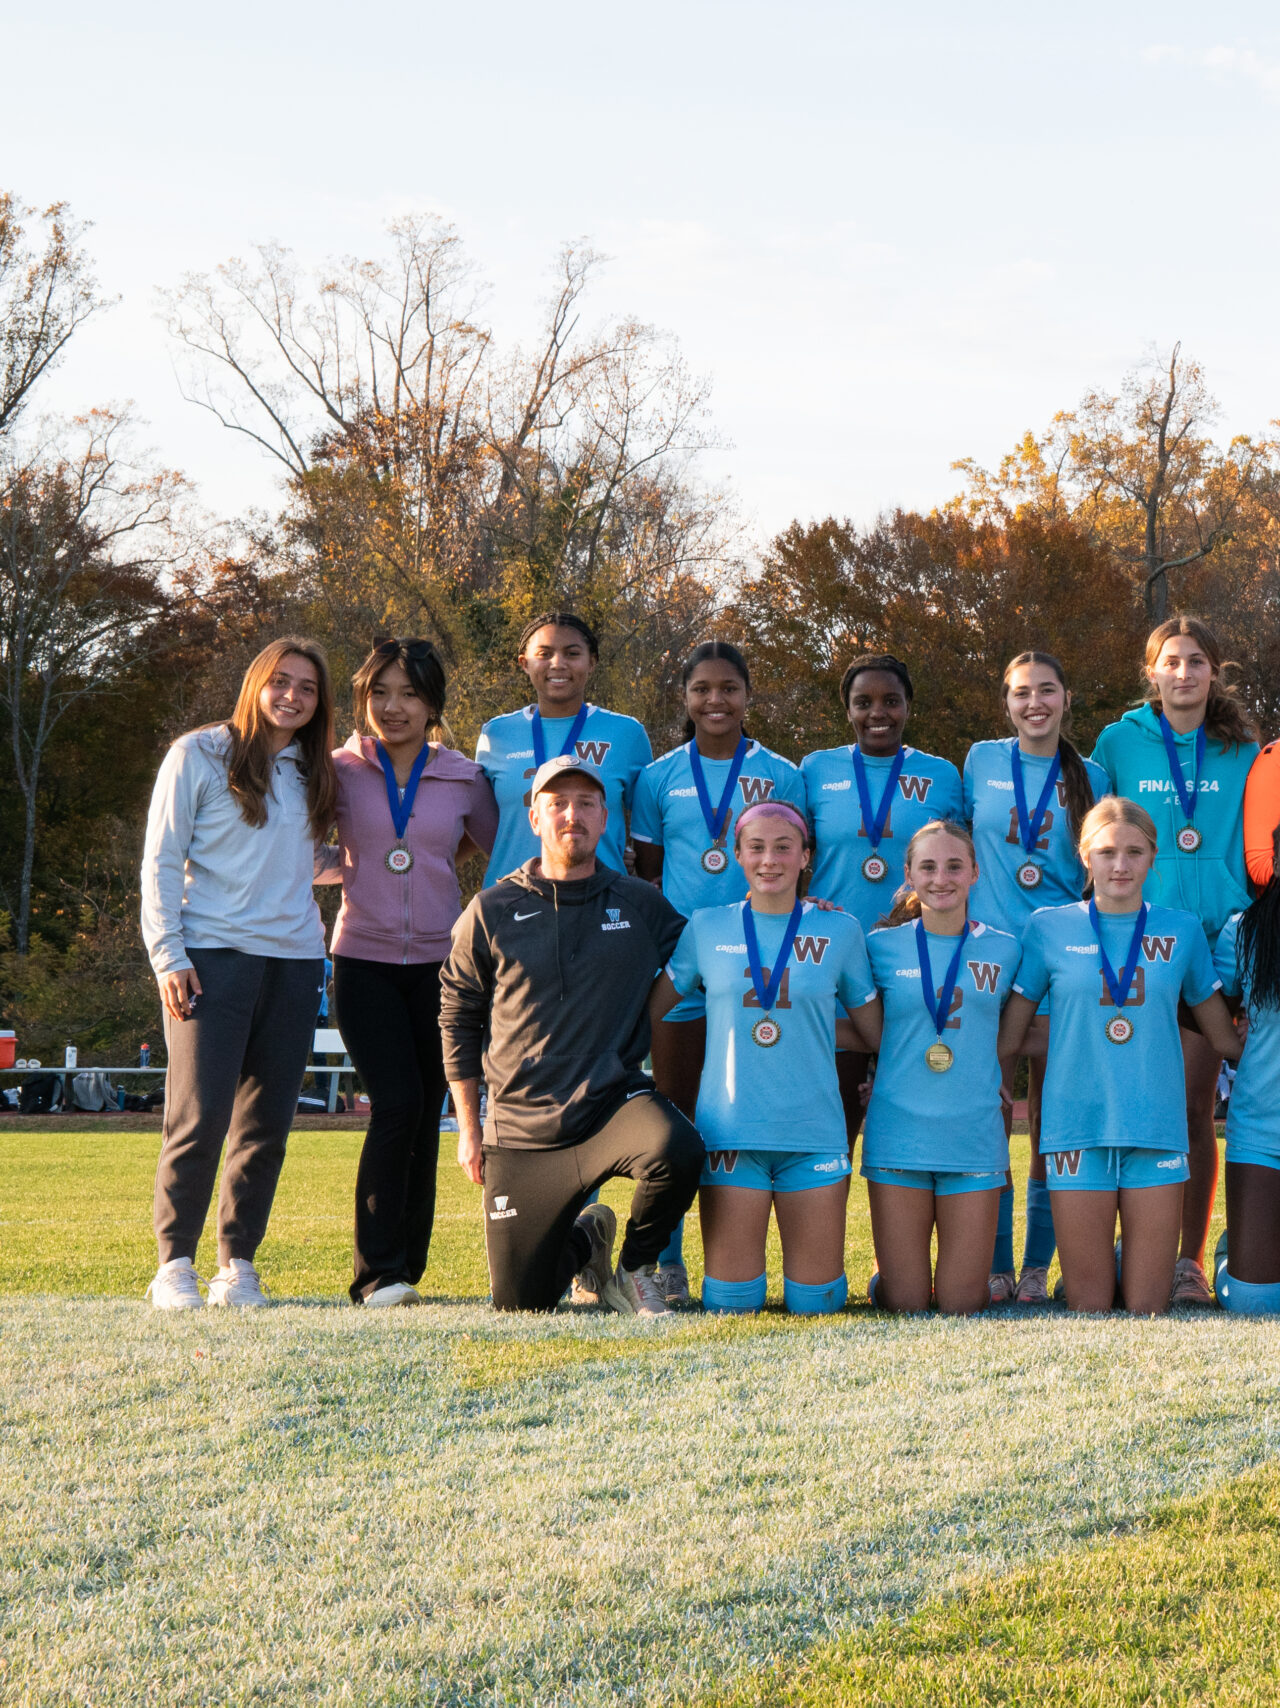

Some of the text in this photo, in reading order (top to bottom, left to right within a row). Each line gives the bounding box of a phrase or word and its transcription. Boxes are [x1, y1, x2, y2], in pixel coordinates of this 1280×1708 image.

[574, 740, 611, 767] W
[739, 776, 775, 804] W
[899, 774, 933, 804] W
[601, 920, 631, 931] SOCCER
[605, 908, 621, 922] W
[793, 935, 830, 965] W
[1141, 935, 1177, 963] W
[742, 966, 792, 1010] 21
[967, 960, 1002, 995] W
[936, 985, 964, 1030] 2
[1053, 1149, 1085, 1176] W
